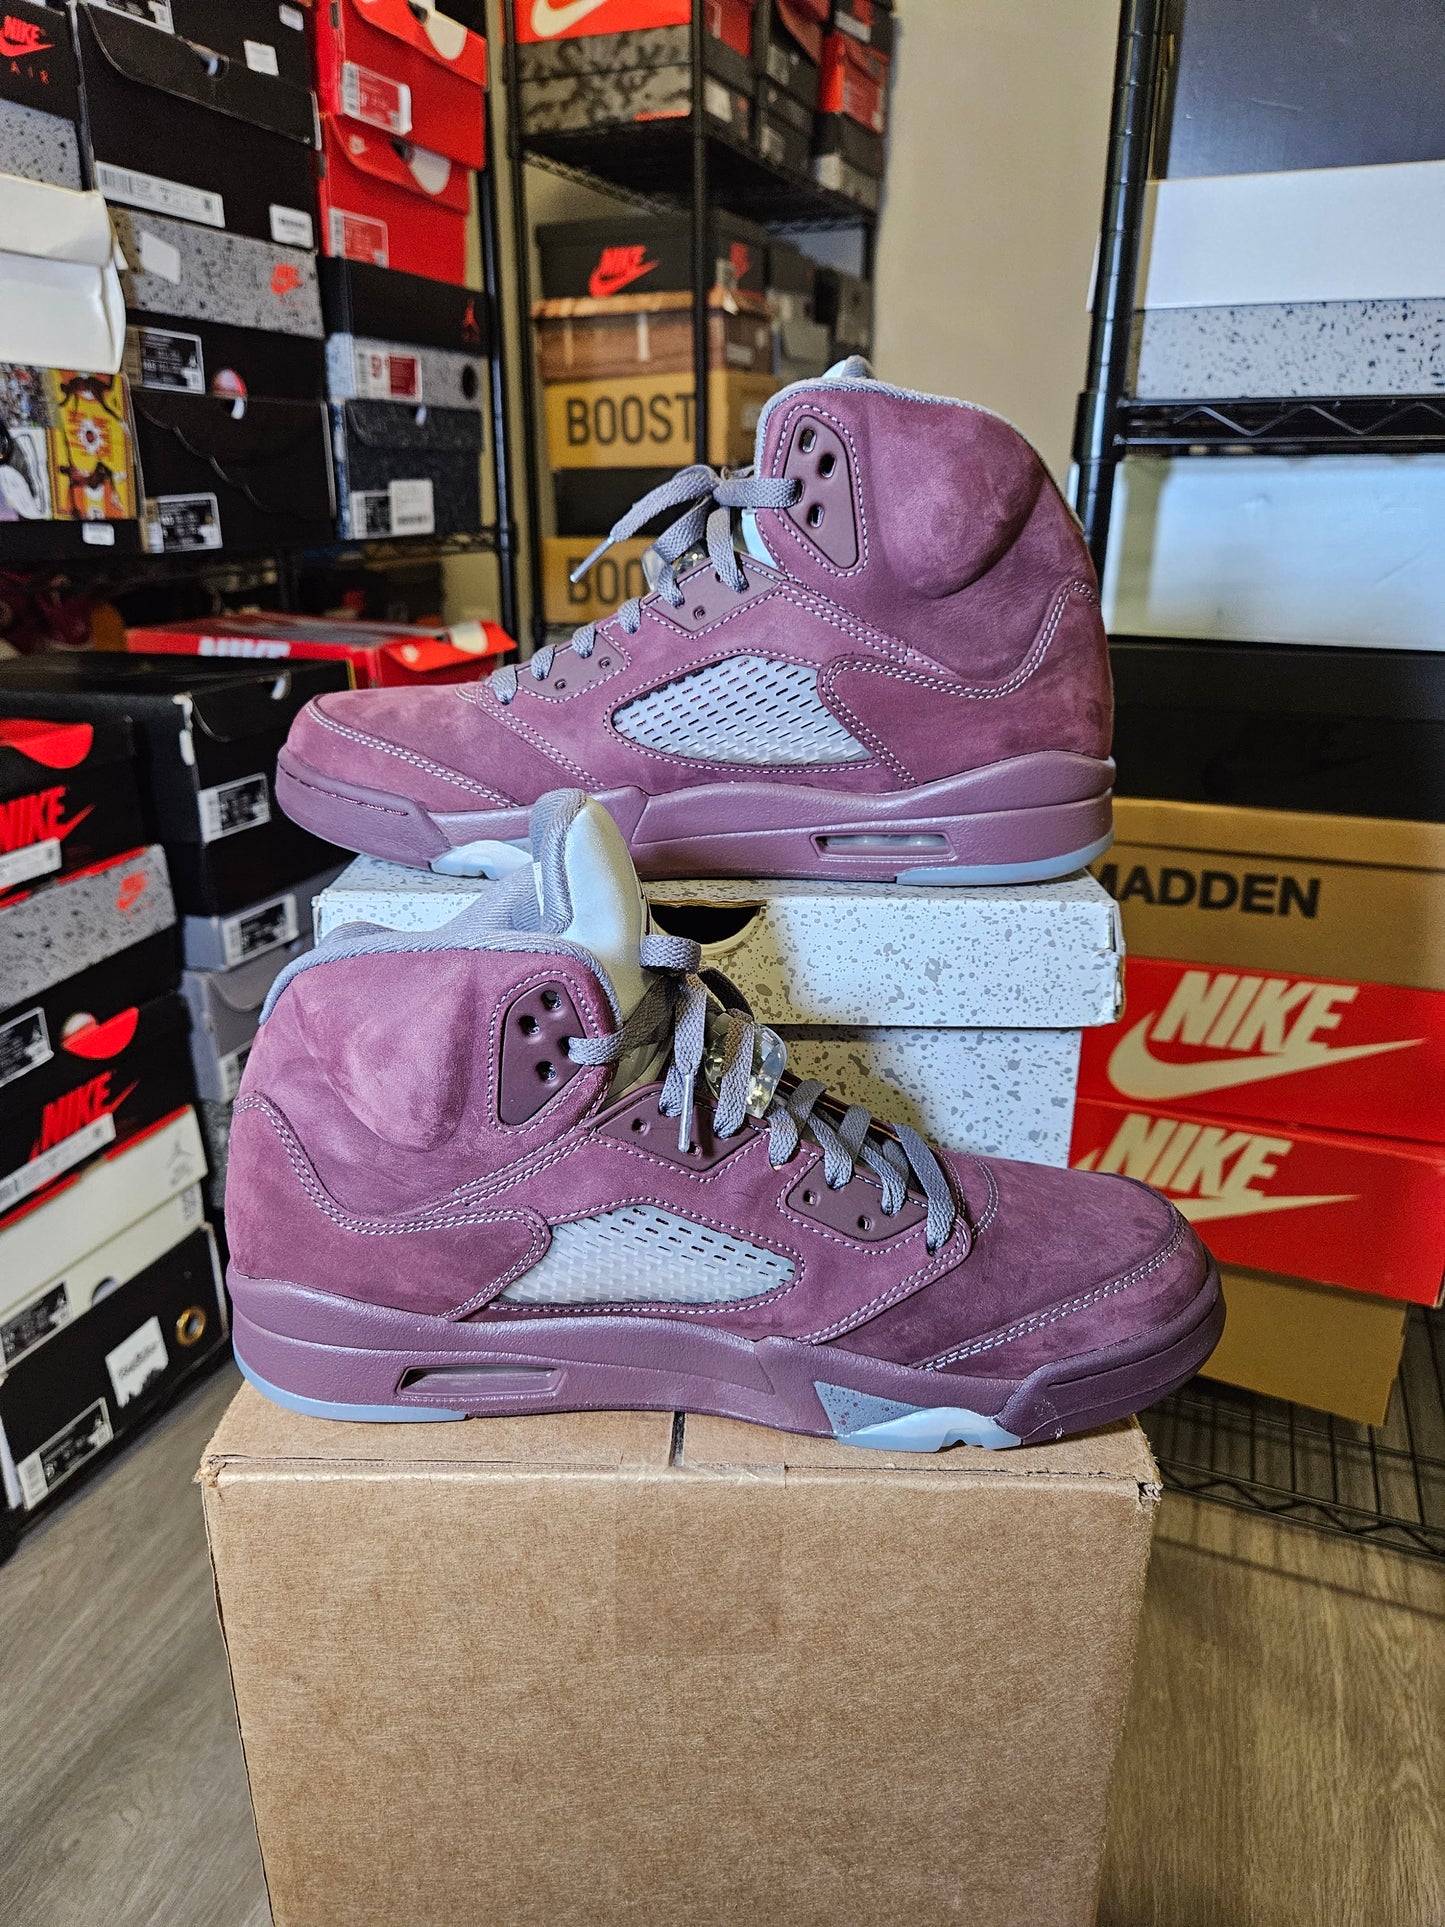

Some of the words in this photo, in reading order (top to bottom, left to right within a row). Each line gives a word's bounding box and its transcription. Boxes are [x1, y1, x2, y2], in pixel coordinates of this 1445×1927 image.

[566, 393, 696, 446] BOOST
[566, 556, 645, 604] BOO
[1151, 971, 1359, 1055] NIKE
[1096, 1112, 1293, 1199] NIKE
